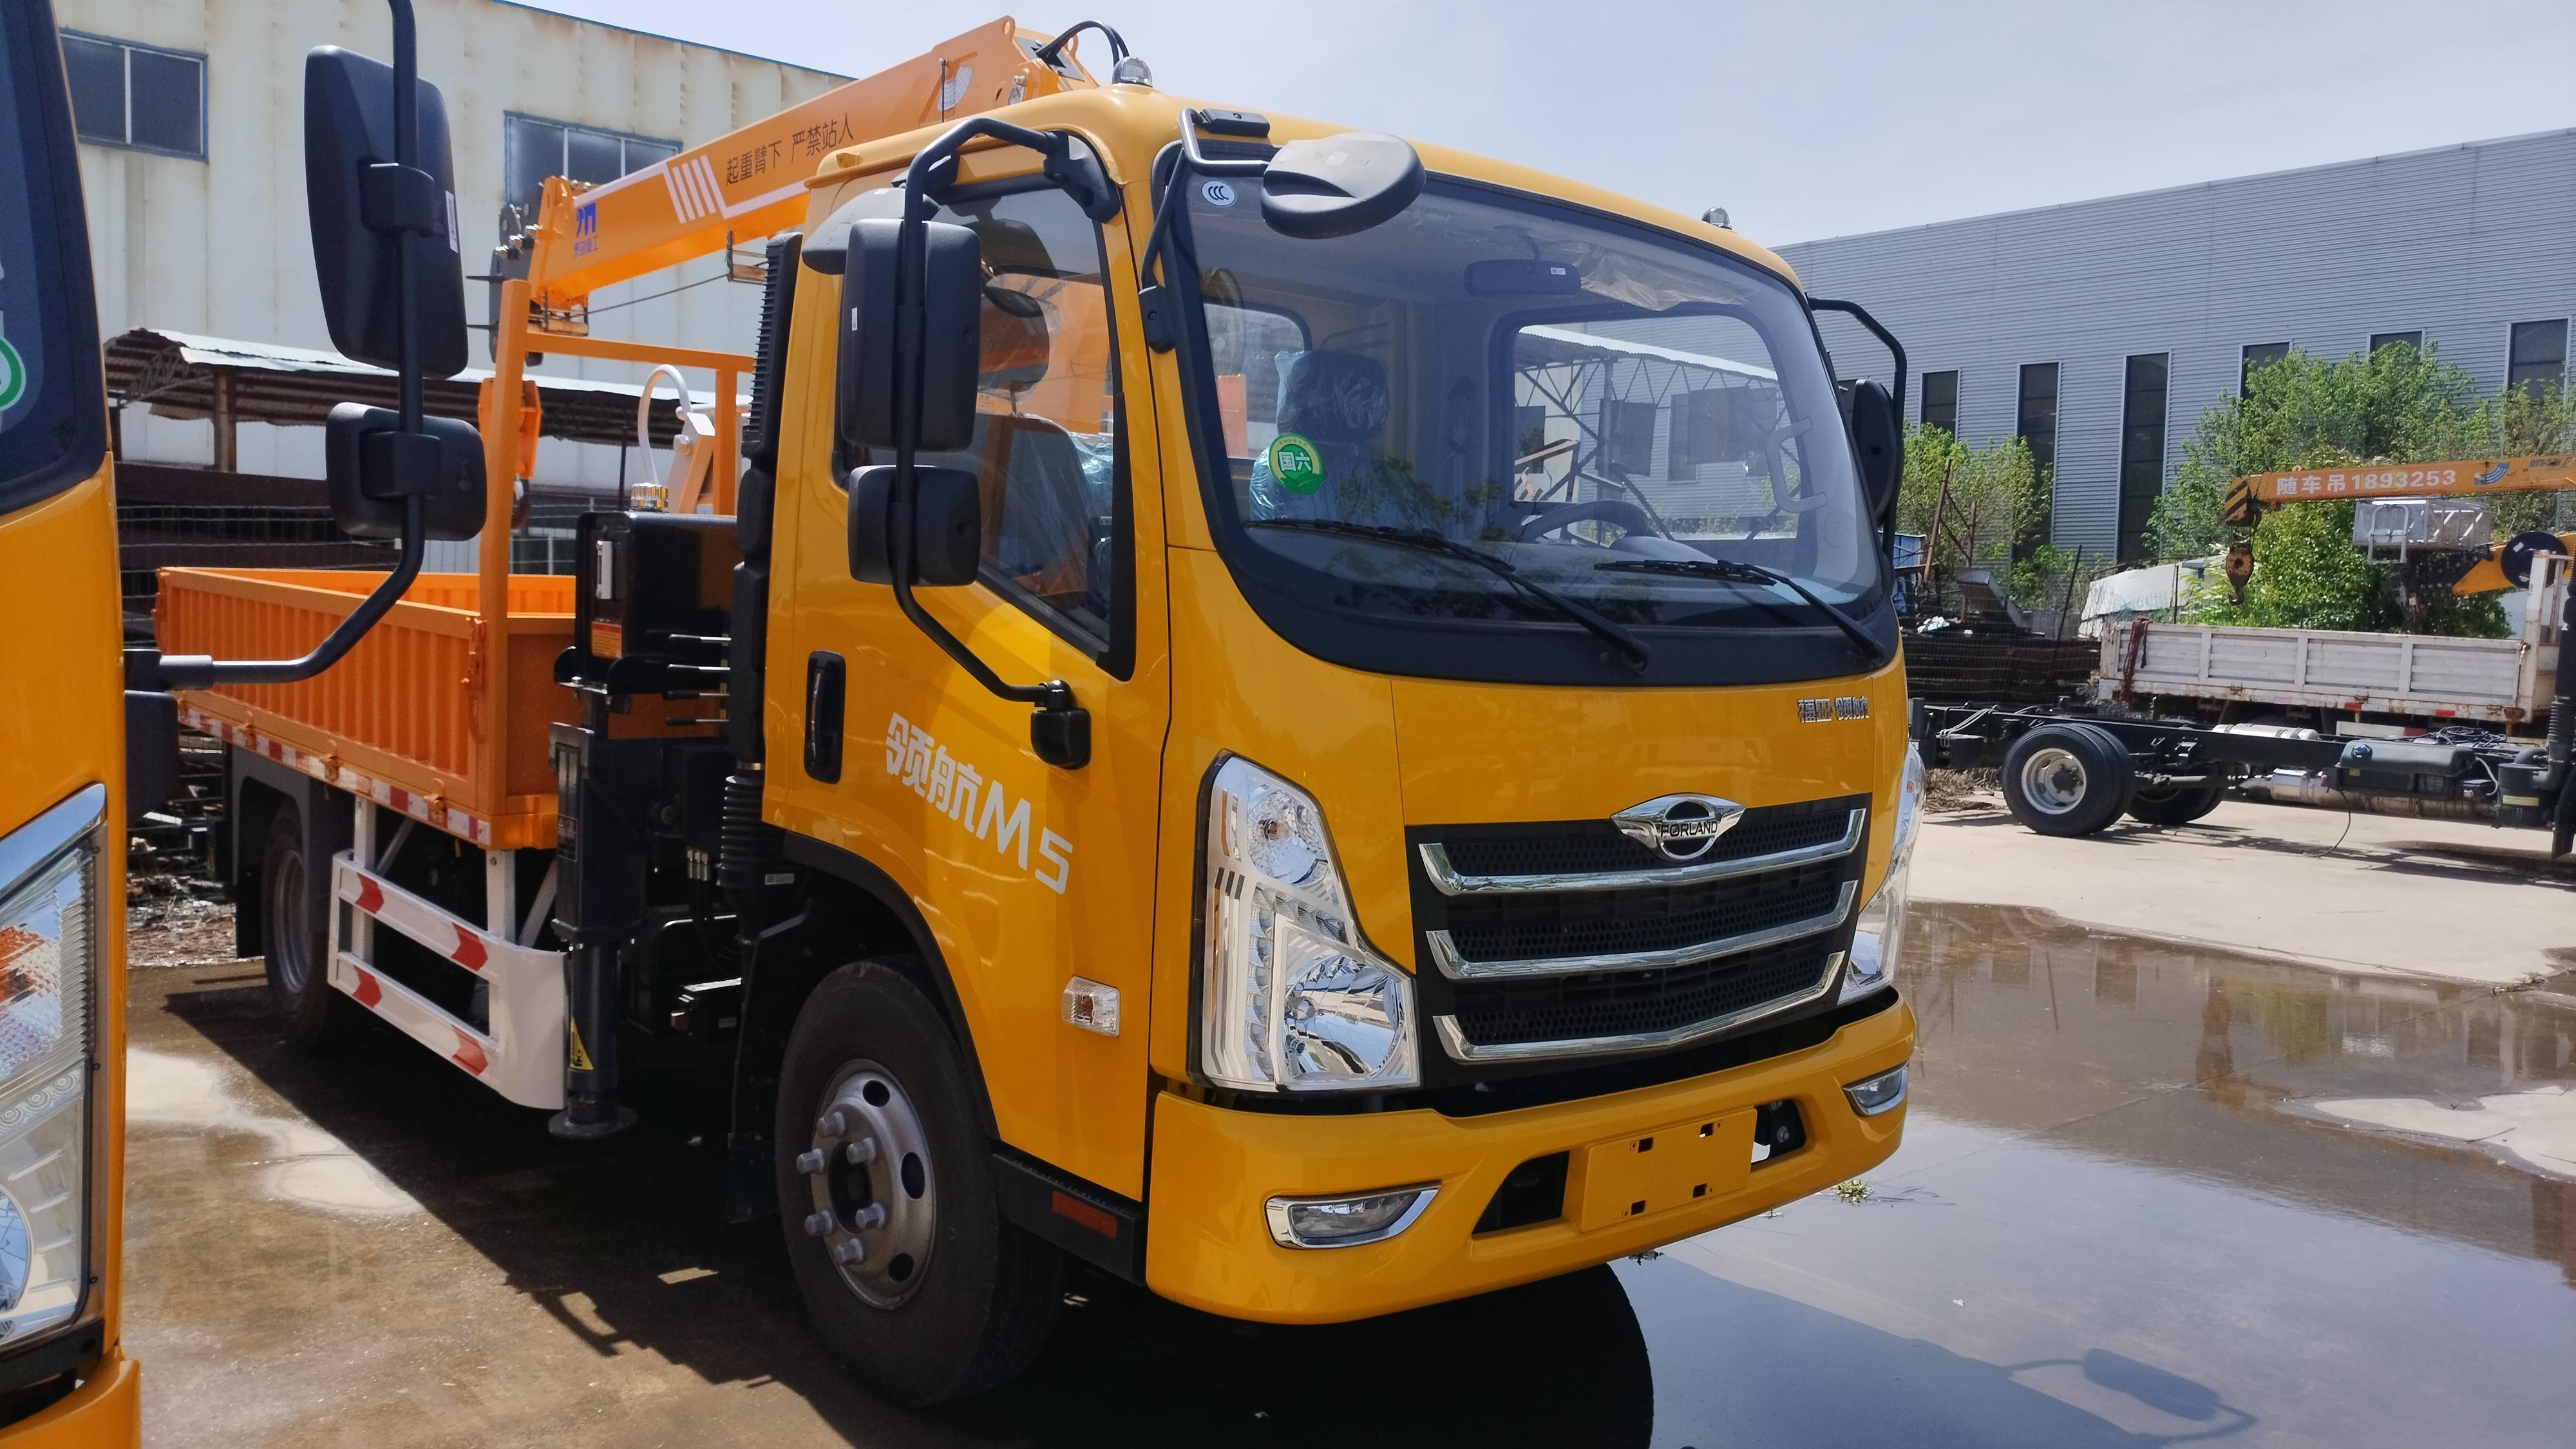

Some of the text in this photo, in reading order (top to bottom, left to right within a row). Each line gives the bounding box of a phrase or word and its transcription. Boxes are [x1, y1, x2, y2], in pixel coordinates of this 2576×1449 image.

[725, 112, 854, 186] 起重臂下 严禁站人
[1278, 451, 1312, 471] 国六
[1660, 821, 1718, 838] FORLAND
